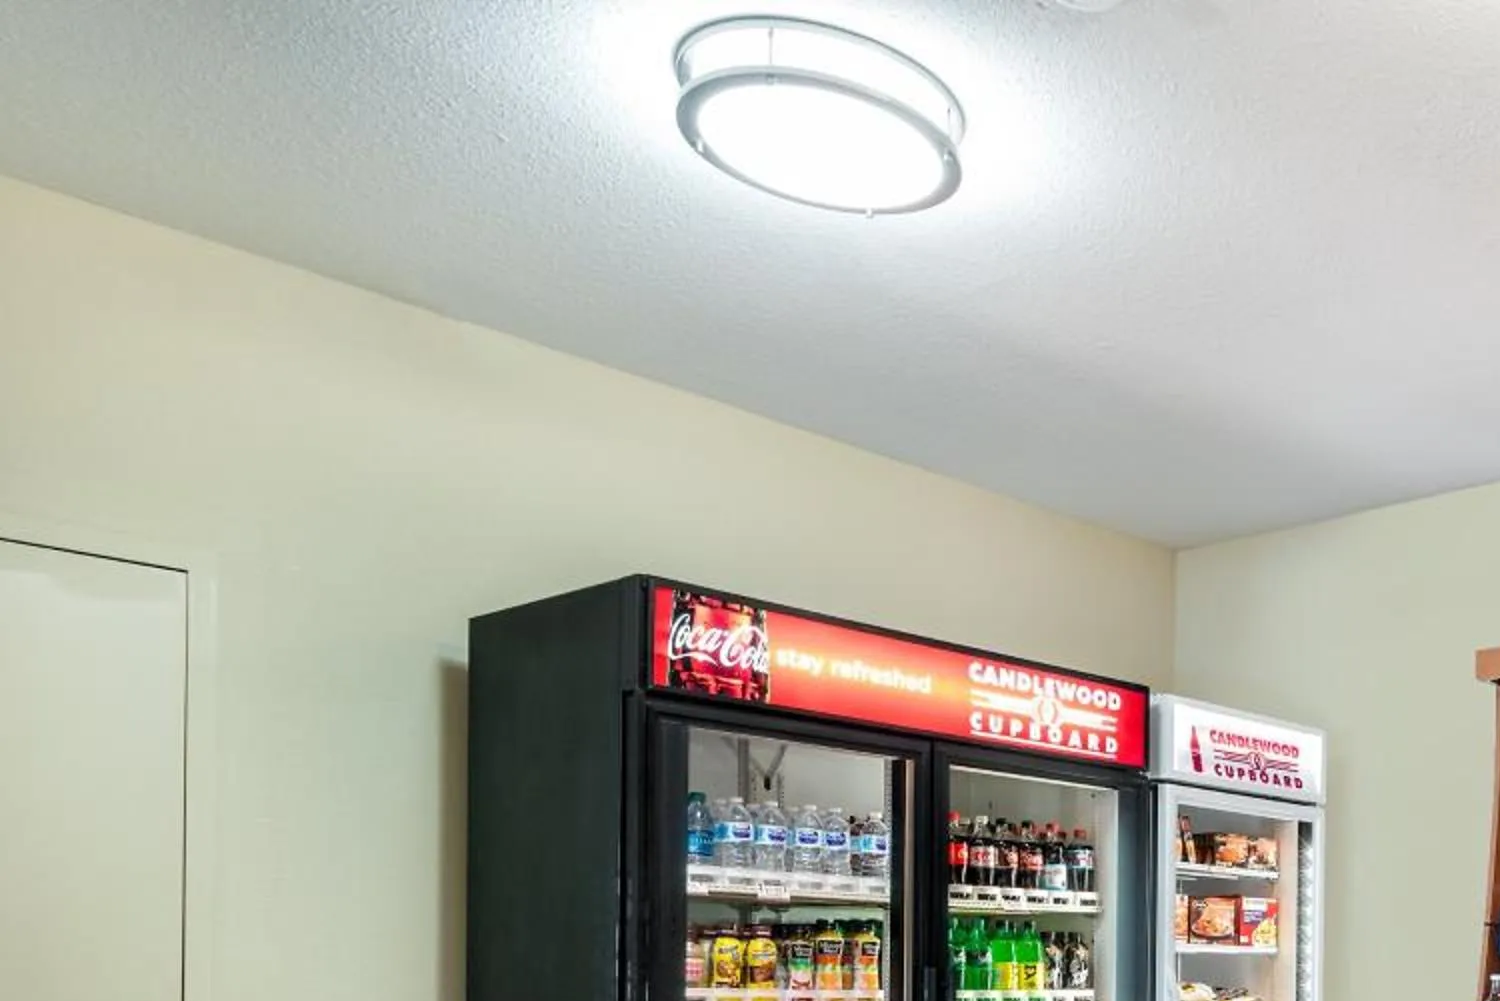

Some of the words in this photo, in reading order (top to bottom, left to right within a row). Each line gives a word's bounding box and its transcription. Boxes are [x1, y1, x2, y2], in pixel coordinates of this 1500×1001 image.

[669, 613, 769, 674] Coca-Cola
[775, 647, 824, 678] stay
[830, 658, 932, 694] refreshed
[968, 661, 1121, 711] CANDLEWOOD
[970, 711, 1118, 753] CUPBOARD
[1209, 729, 1300, 759] CANDLEWOOD
[1213, 763, 1303, 790] CUPBOARD
